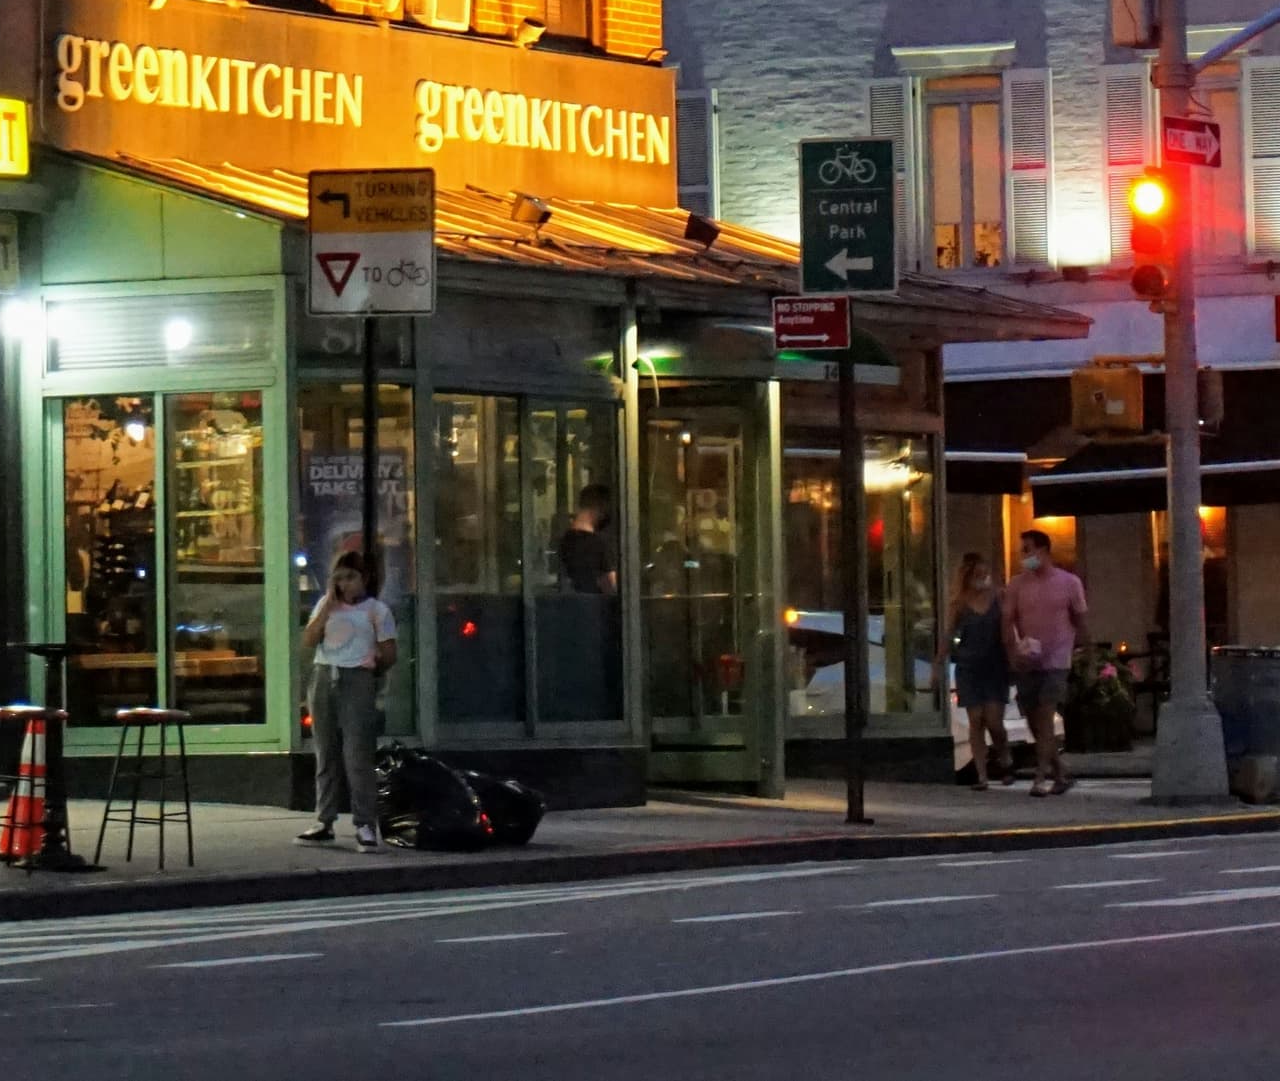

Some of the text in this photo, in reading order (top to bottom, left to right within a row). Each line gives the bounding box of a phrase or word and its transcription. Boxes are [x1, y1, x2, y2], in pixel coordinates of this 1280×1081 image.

[56, 34, 363, 128] greenKITCHEN
[417, 80, 670, 165] greenKITCHEN
[354, 182, 427, 198] TURNING
[354, 206, 428, 223] VEHICLES
[819, 200, 879, 216] Central
[829, 224, 867, 240] Park
[362, 267, 383, 282] TO
[777, 302, 836, 313] NO STOPPING
[310, 481, 358, 496] TAKE
